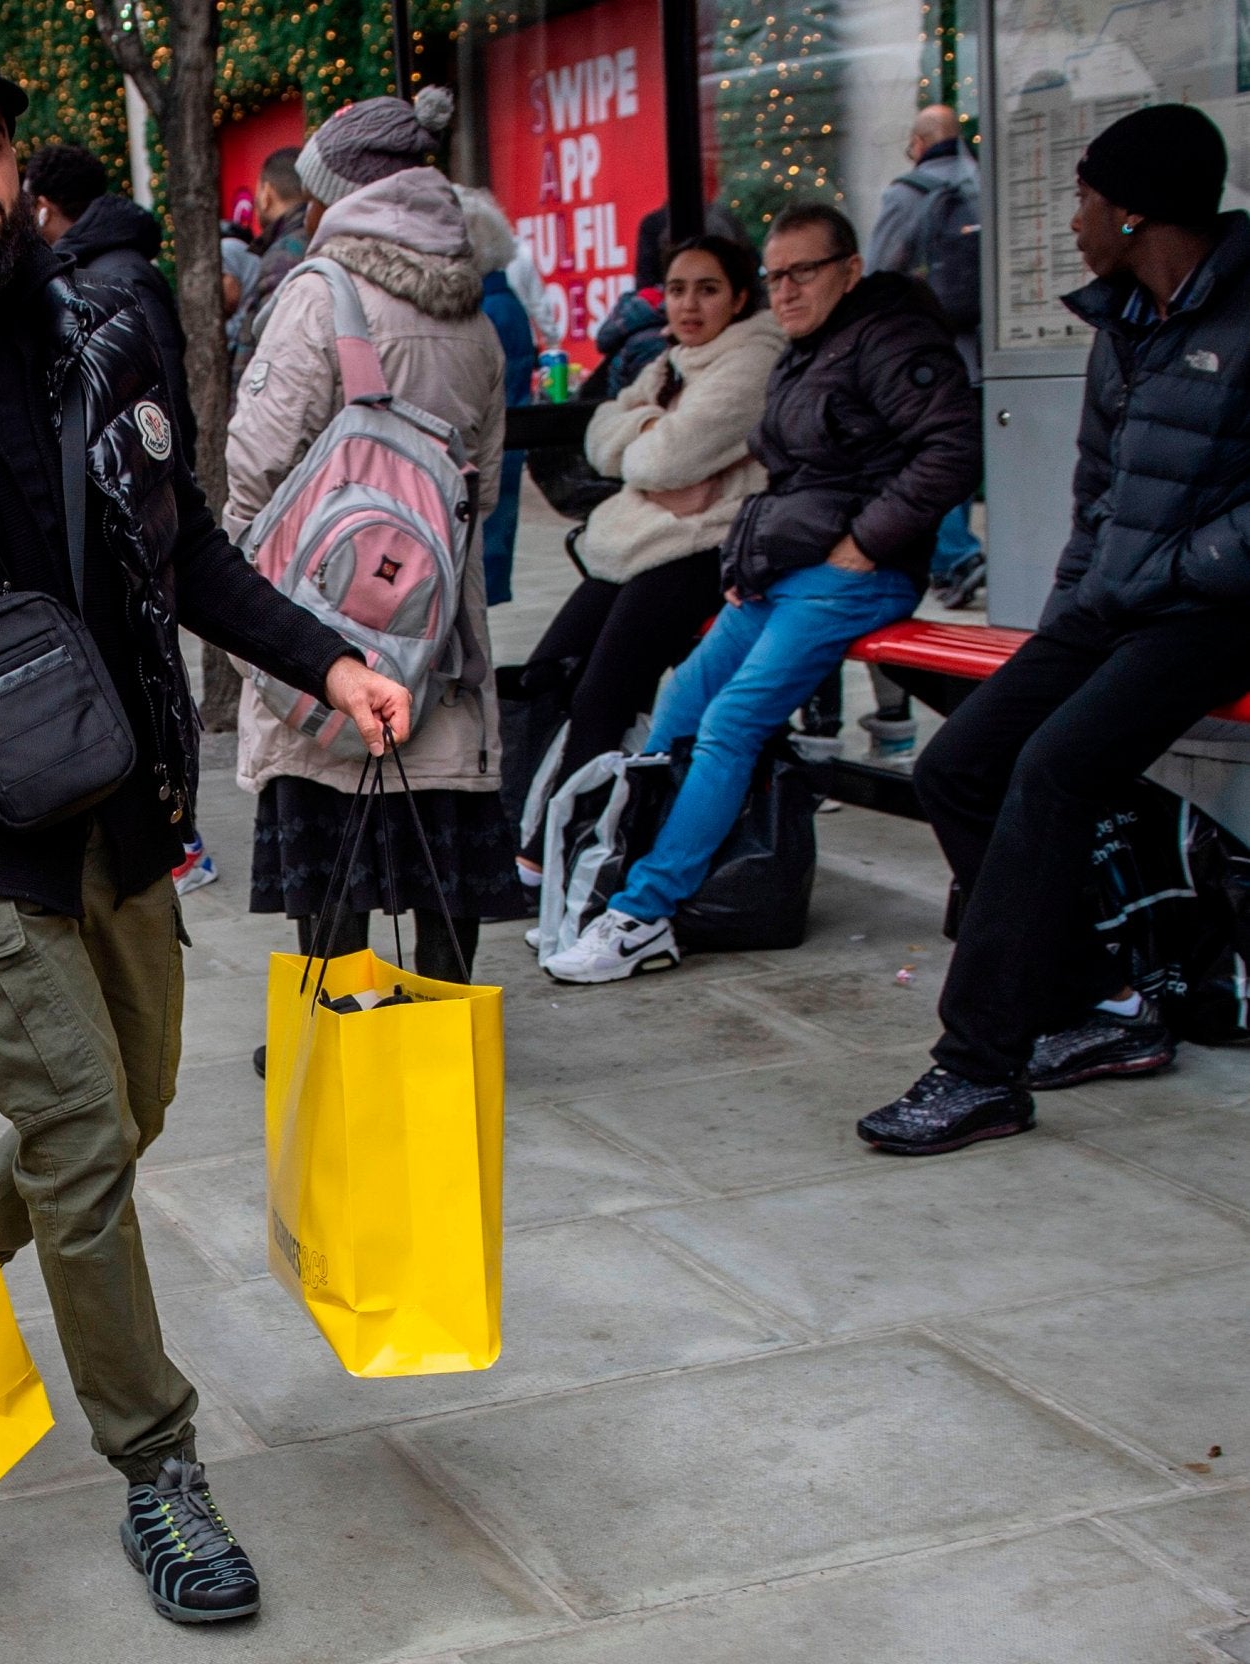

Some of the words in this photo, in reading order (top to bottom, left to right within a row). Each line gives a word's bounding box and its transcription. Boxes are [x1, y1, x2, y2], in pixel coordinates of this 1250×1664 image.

[529, 46, 639, 135] SWIPE
[539, 132, 601, 204] APP
[515, 202, 627, 276] FULFIL
